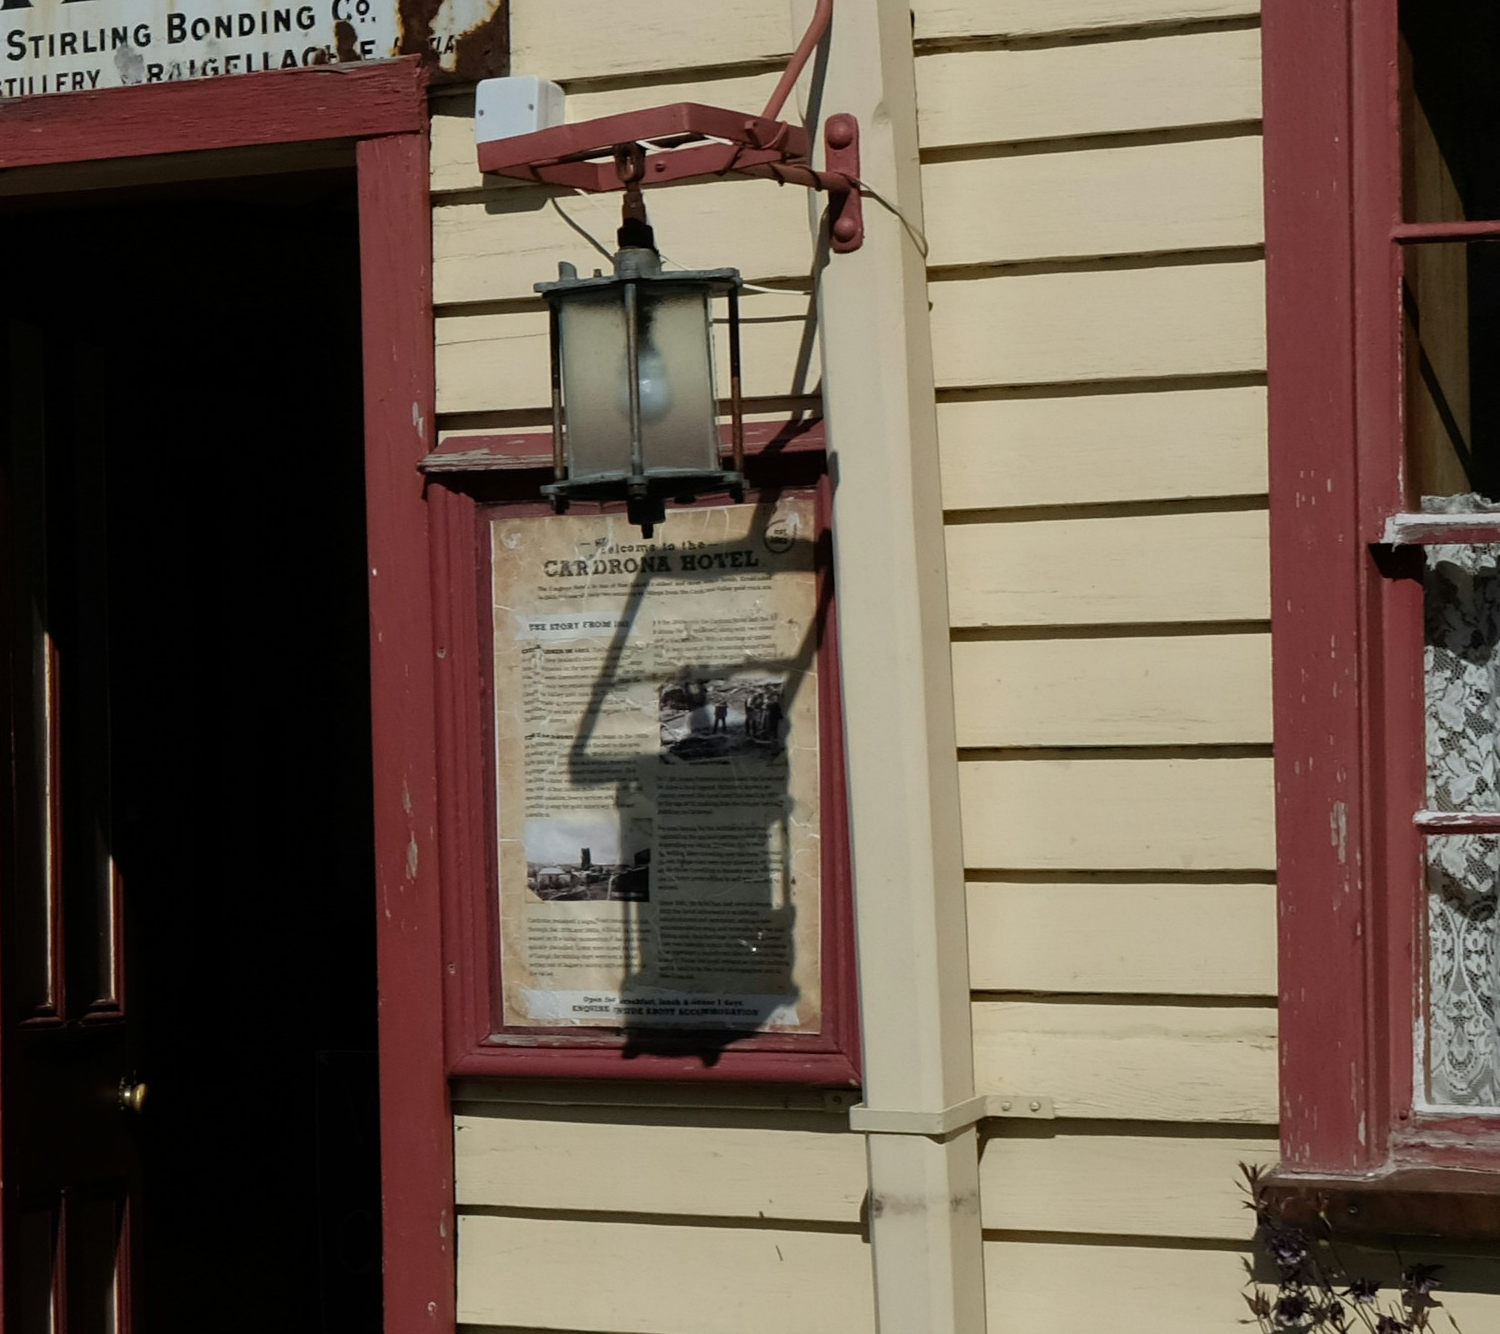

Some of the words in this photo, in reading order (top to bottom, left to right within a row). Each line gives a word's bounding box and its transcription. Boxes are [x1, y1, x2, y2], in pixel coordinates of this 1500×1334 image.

[6, 23, 152, 62] STIRLING
[167, 5, 317, 45] BONDING
[682, 540, 705, 551] the
[543, 555, 672, 577] CARDRONA
[679, 550, 760, 572] HOTEL
